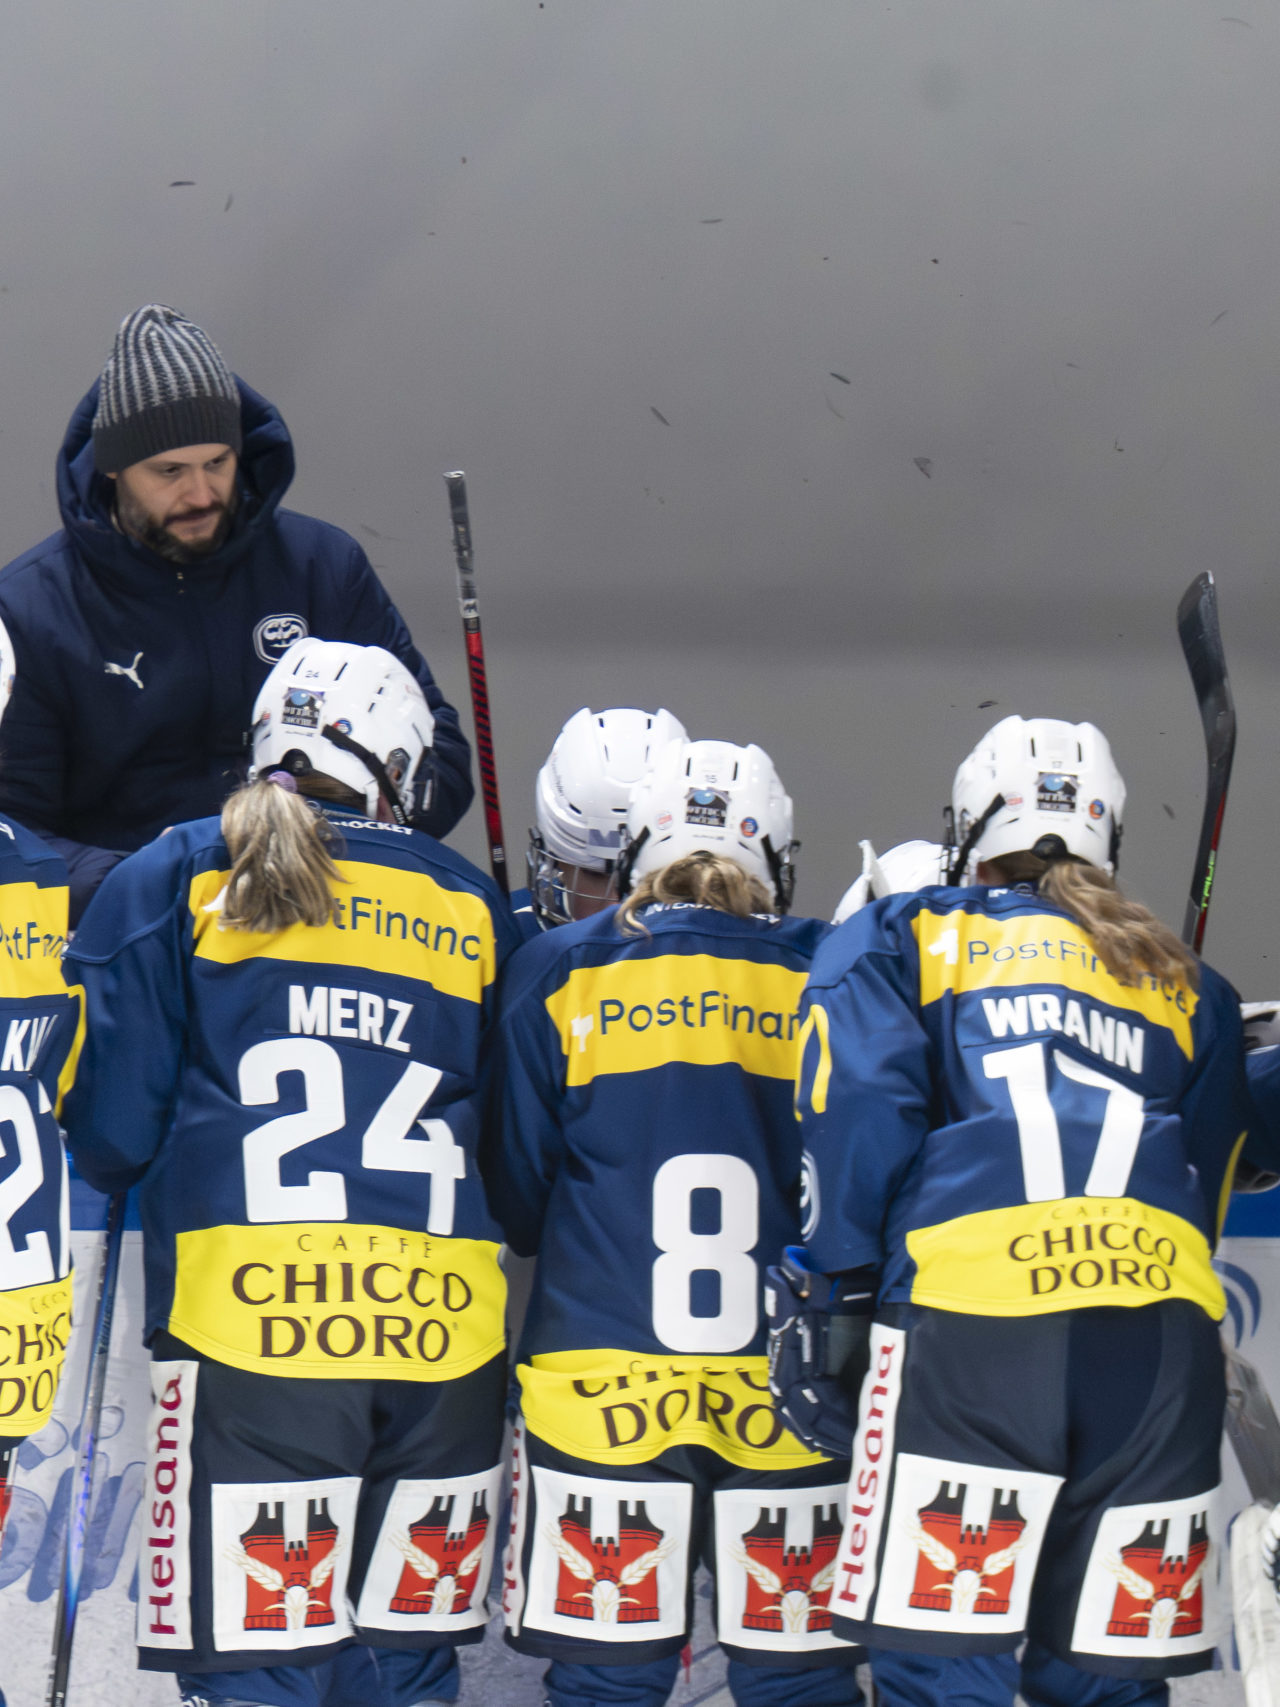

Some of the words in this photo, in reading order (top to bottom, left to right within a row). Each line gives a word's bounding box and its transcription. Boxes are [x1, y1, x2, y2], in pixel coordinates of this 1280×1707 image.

[334, 896, 482, 962] tFinanc
[288, 985, 414, 1053] MERZ
[599, 989, 800, 1042] PostFinan
[981, 993, 1145, 1074] WRANN
[238, 1037, 466, 1236] 24
[982, 1042, 1146, 1204] 17
[652, 1153, 759, 1353] 8
[1008, 1222, 1177, 1267] CHICCO
[1030, 1257, 1171, 1296] D'ORO
[232, 1262, 472, 1313] CHICCO
[258, 1313, 450, 1363] D'ORO
[600, 1381, 784, 1449] D'ORO
[148, 1372, 182, 1635] Helsana
[838, 1342, 896, 1604] Helsana
